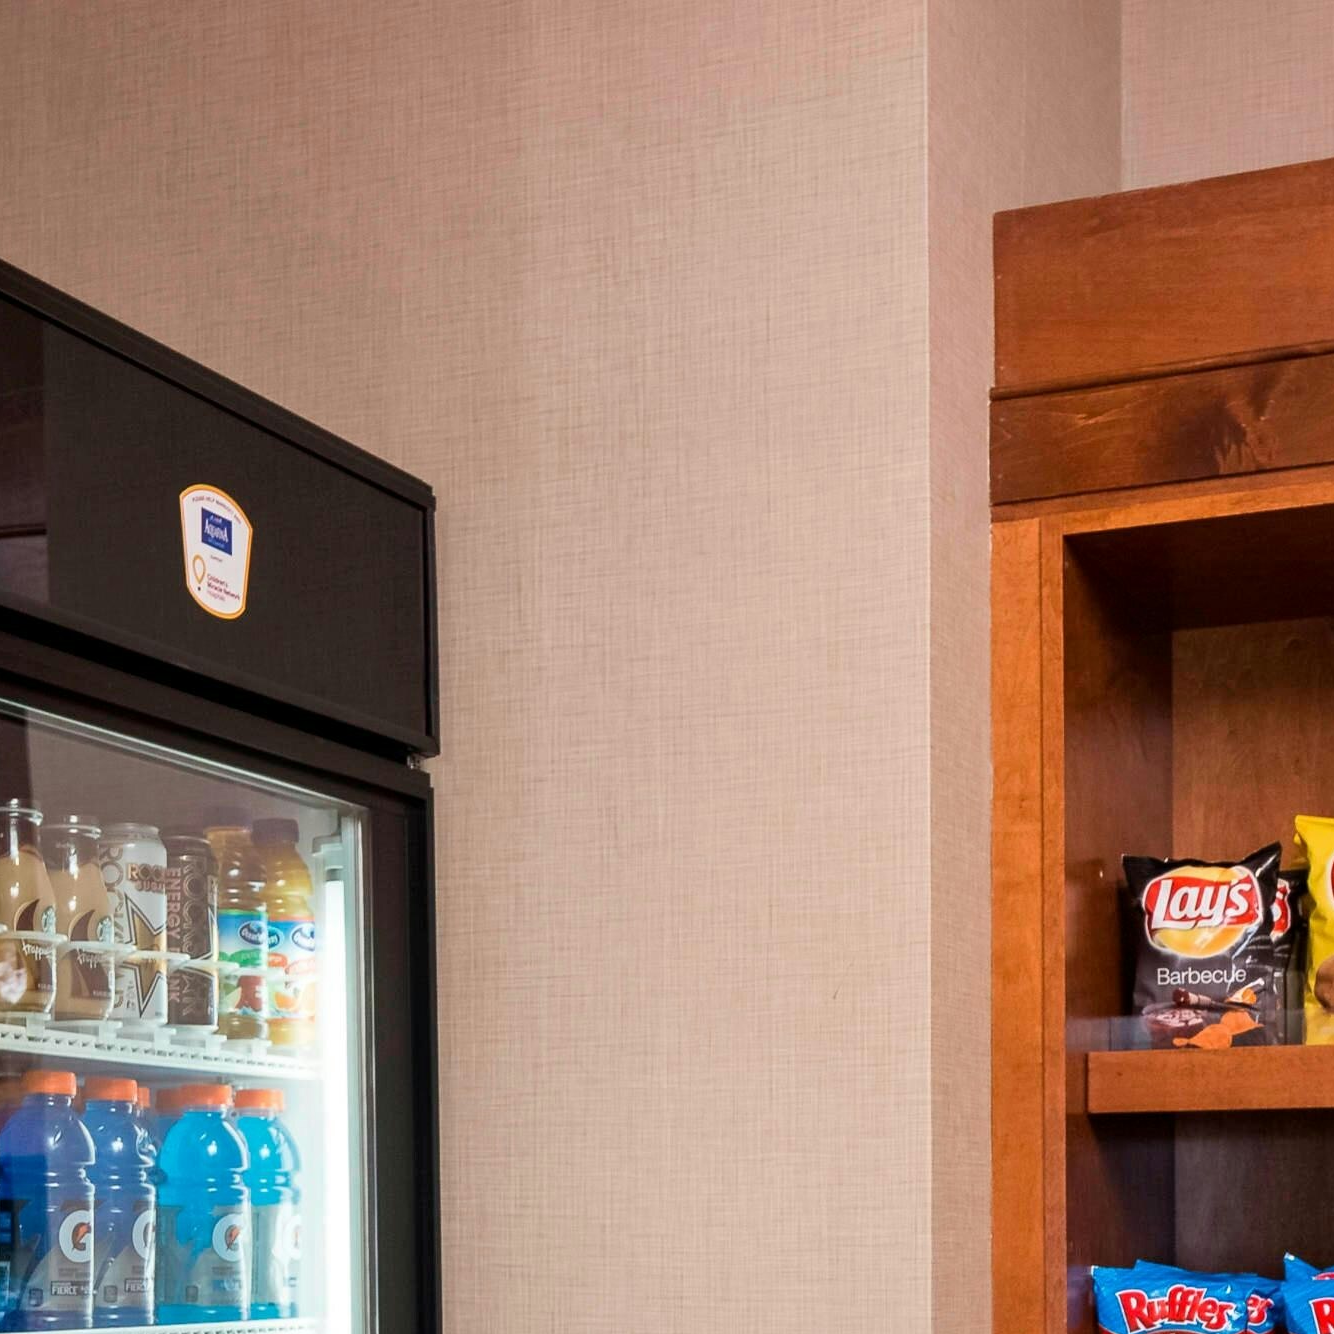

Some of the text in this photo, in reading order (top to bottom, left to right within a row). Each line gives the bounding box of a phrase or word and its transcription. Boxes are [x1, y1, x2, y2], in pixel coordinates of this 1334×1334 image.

[1150, 877, 1253, 929] Lay's
[1157, 967, 1247, 986] Barbecue
[1117, 1284, 1236, 1334] Ruffles
